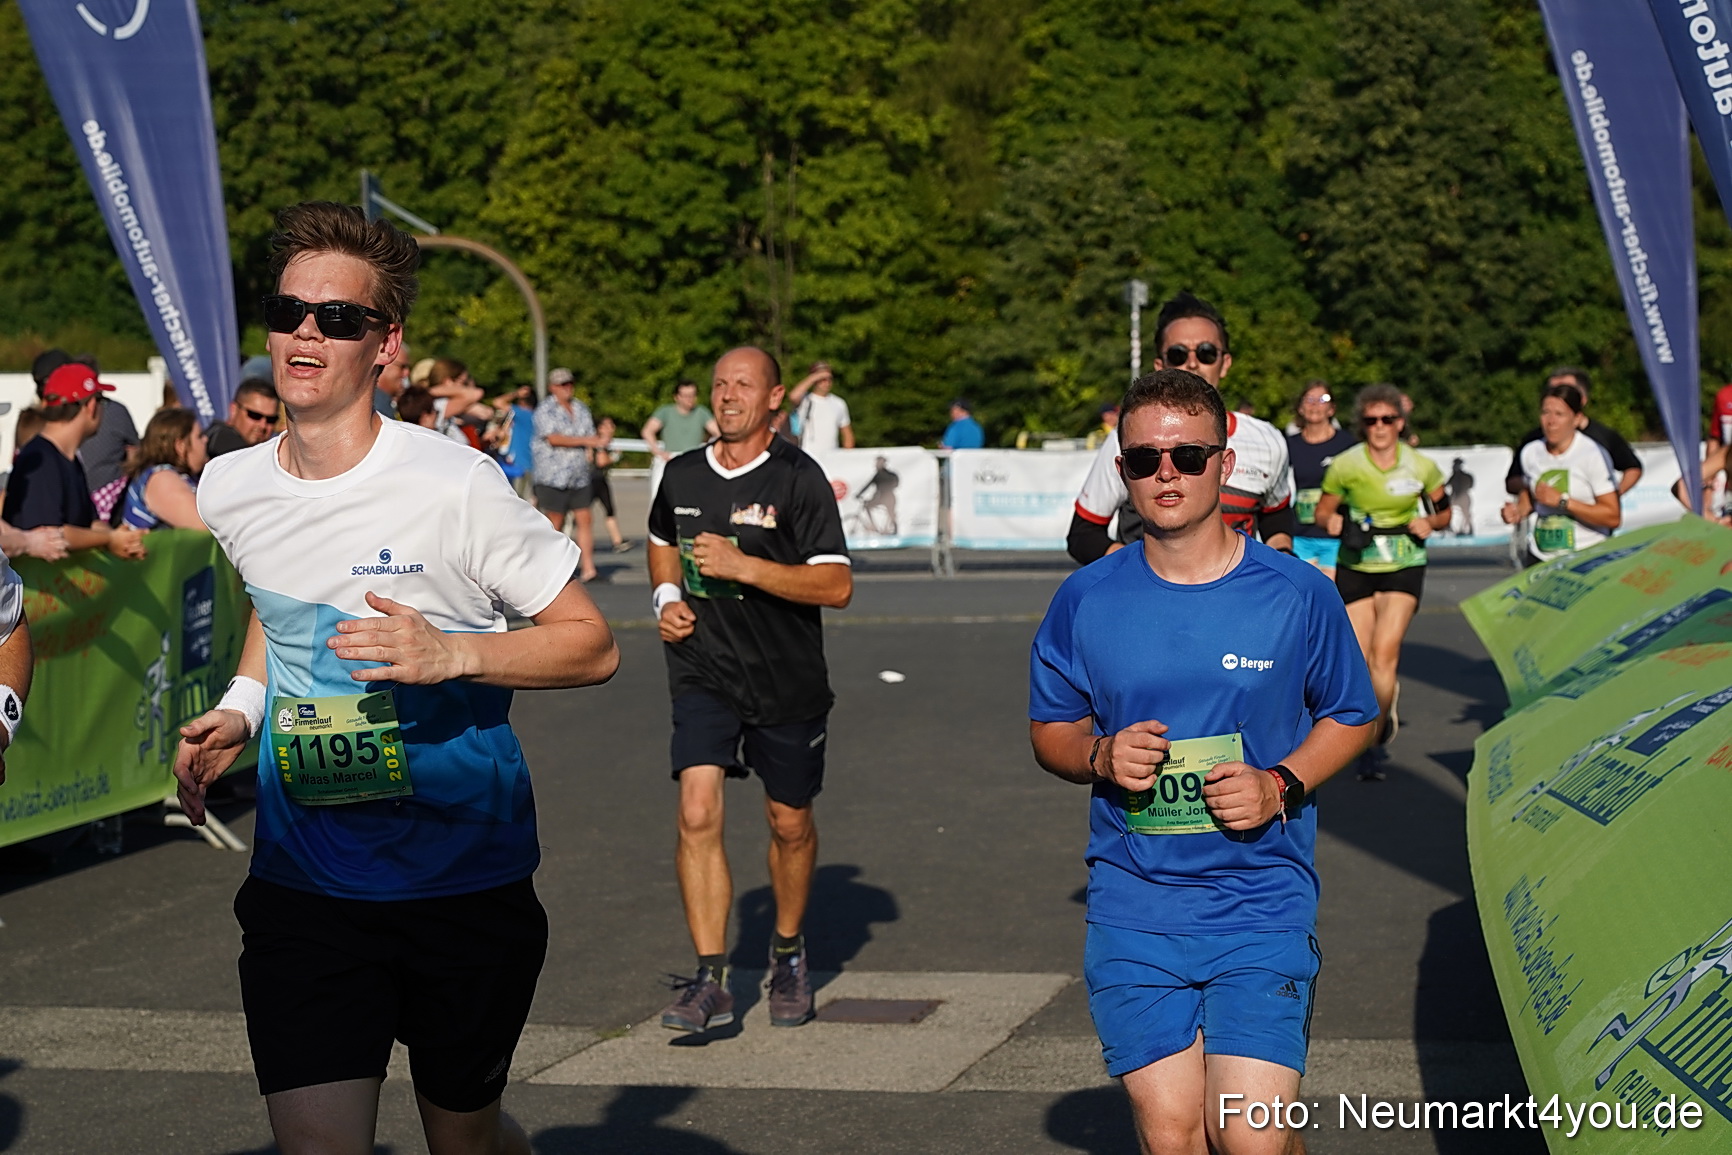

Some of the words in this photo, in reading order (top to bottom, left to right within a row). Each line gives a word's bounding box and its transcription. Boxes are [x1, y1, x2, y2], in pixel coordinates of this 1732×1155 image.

[351, 564, 424, 576] SCHABMÜLLER
[1240, 657, 1274, 672] Berger
[294, 715, 332, 727] Firmenlauf
[309, 723, 333, 731] neumarkt
[290, 731, 380, 770] 1195
[382, 733, 402, 782] 2022
[278, 746, 293, 783] RUN
[298, 773, 330, 785] Waas
[332, 768, 377, 784] Marcel
[1159, 772, 1202, 804] 09
[1147, 807, 1183, 818] Müller
[1185, 804, 1209, 816] Jon
[1275, 990, 1301, 1000] adidas
